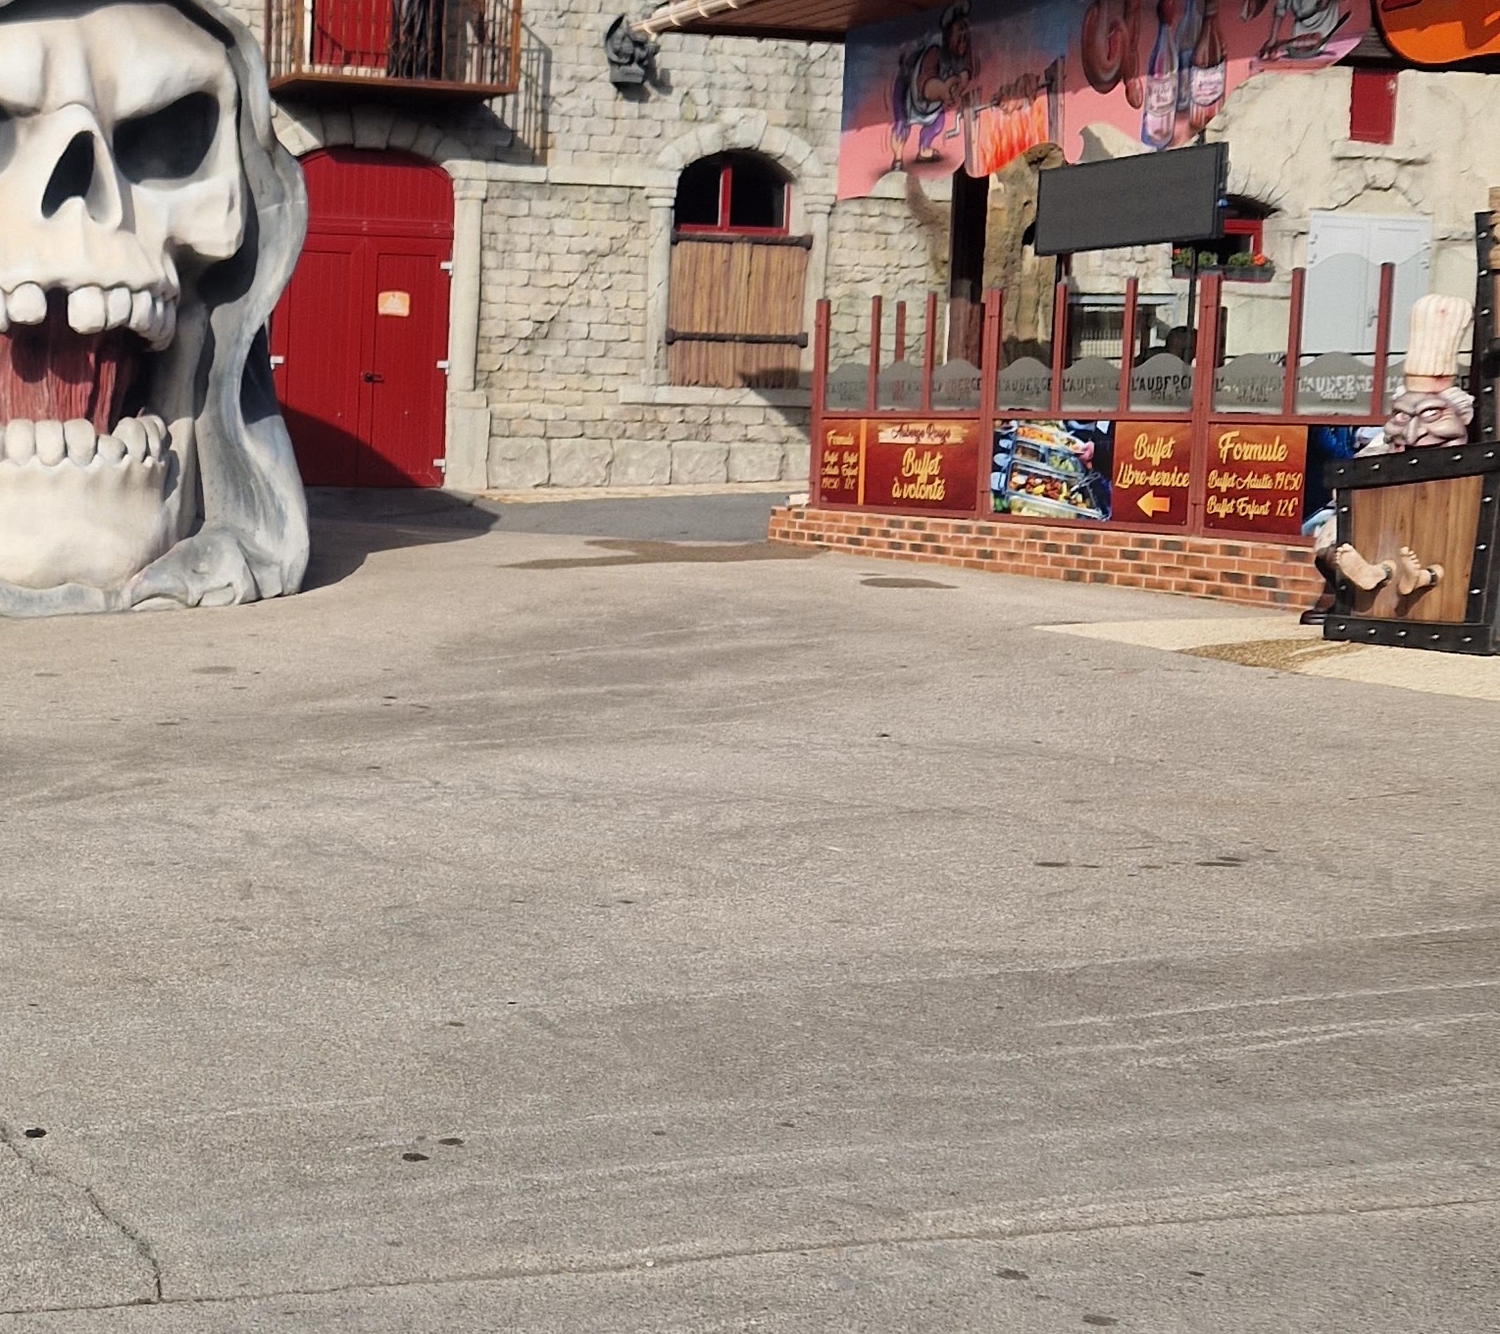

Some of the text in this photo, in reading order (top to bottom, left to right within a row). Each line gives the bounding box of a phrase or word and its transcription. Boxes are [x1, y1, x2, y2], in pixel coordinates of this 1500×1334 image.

[1133, 433, 1176, 465] Buffet
[1218, 430, 1289, 464] Formule
[901, 447, 943, 483] Buffet
[1115, 461, 1190, 489] Libre-service
[892, 476, 946, 501] à volonté
[1207, 469, 1237, 493] Buffet
[1236, 470, 1274, 490] Adulte
[1206, 495, 1236, 519] Buffet
[1236, 496, 1272, 521] Enfant
